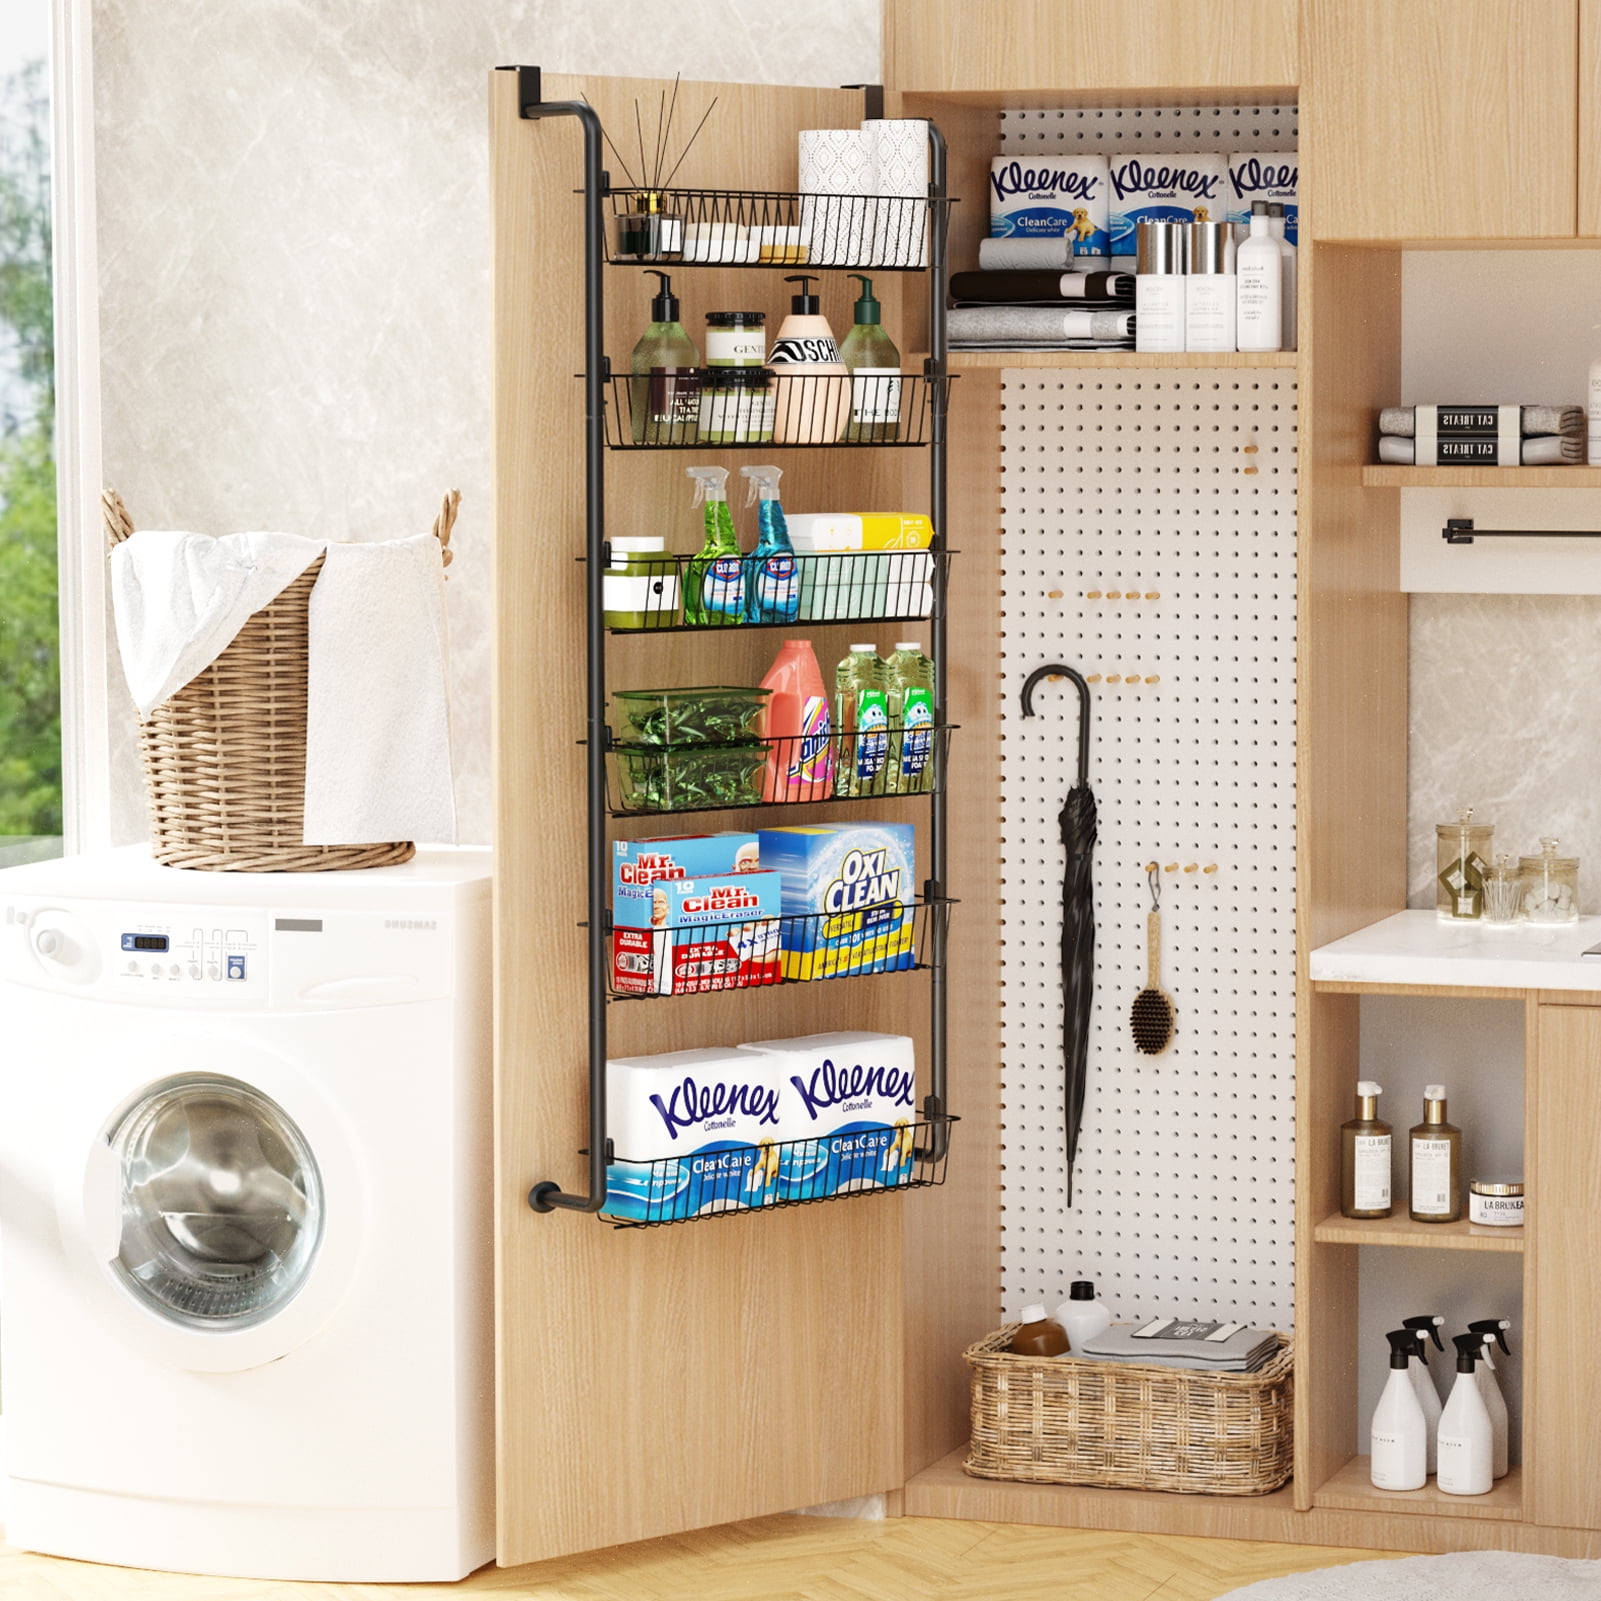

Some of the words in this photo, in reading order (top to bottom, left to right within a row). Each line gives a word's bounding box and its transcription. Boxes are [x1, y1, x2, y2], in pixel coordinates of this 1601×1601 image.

[991, 161, 1098, 202] Kleenex
[1110, 160, 1219, 200] Kleenex
[1028, 192, 1057, 200] Cottonelle
[1148, 190, 1177, 199] Cottonelle
[616, 841, 628, 851] 10
[637, 853, 674, 870] Mr.
[842, 849, 886, 885] OXI
[620, 863, 686, 885] Clean
[675, 881, 694, 891] 10
[710, 886, 748, 899] Mr.
[824, 869, 900, 918] CLEAN
[682, 896, 759, 913] Clean
[790, 1059, 915, 1120] Kleenex
[649, 1076, 781, 1140] Kleenex
[842, 1099, 873, 1113] Cottonelle
[703, 1117, 737, 1132] Cottonelle
